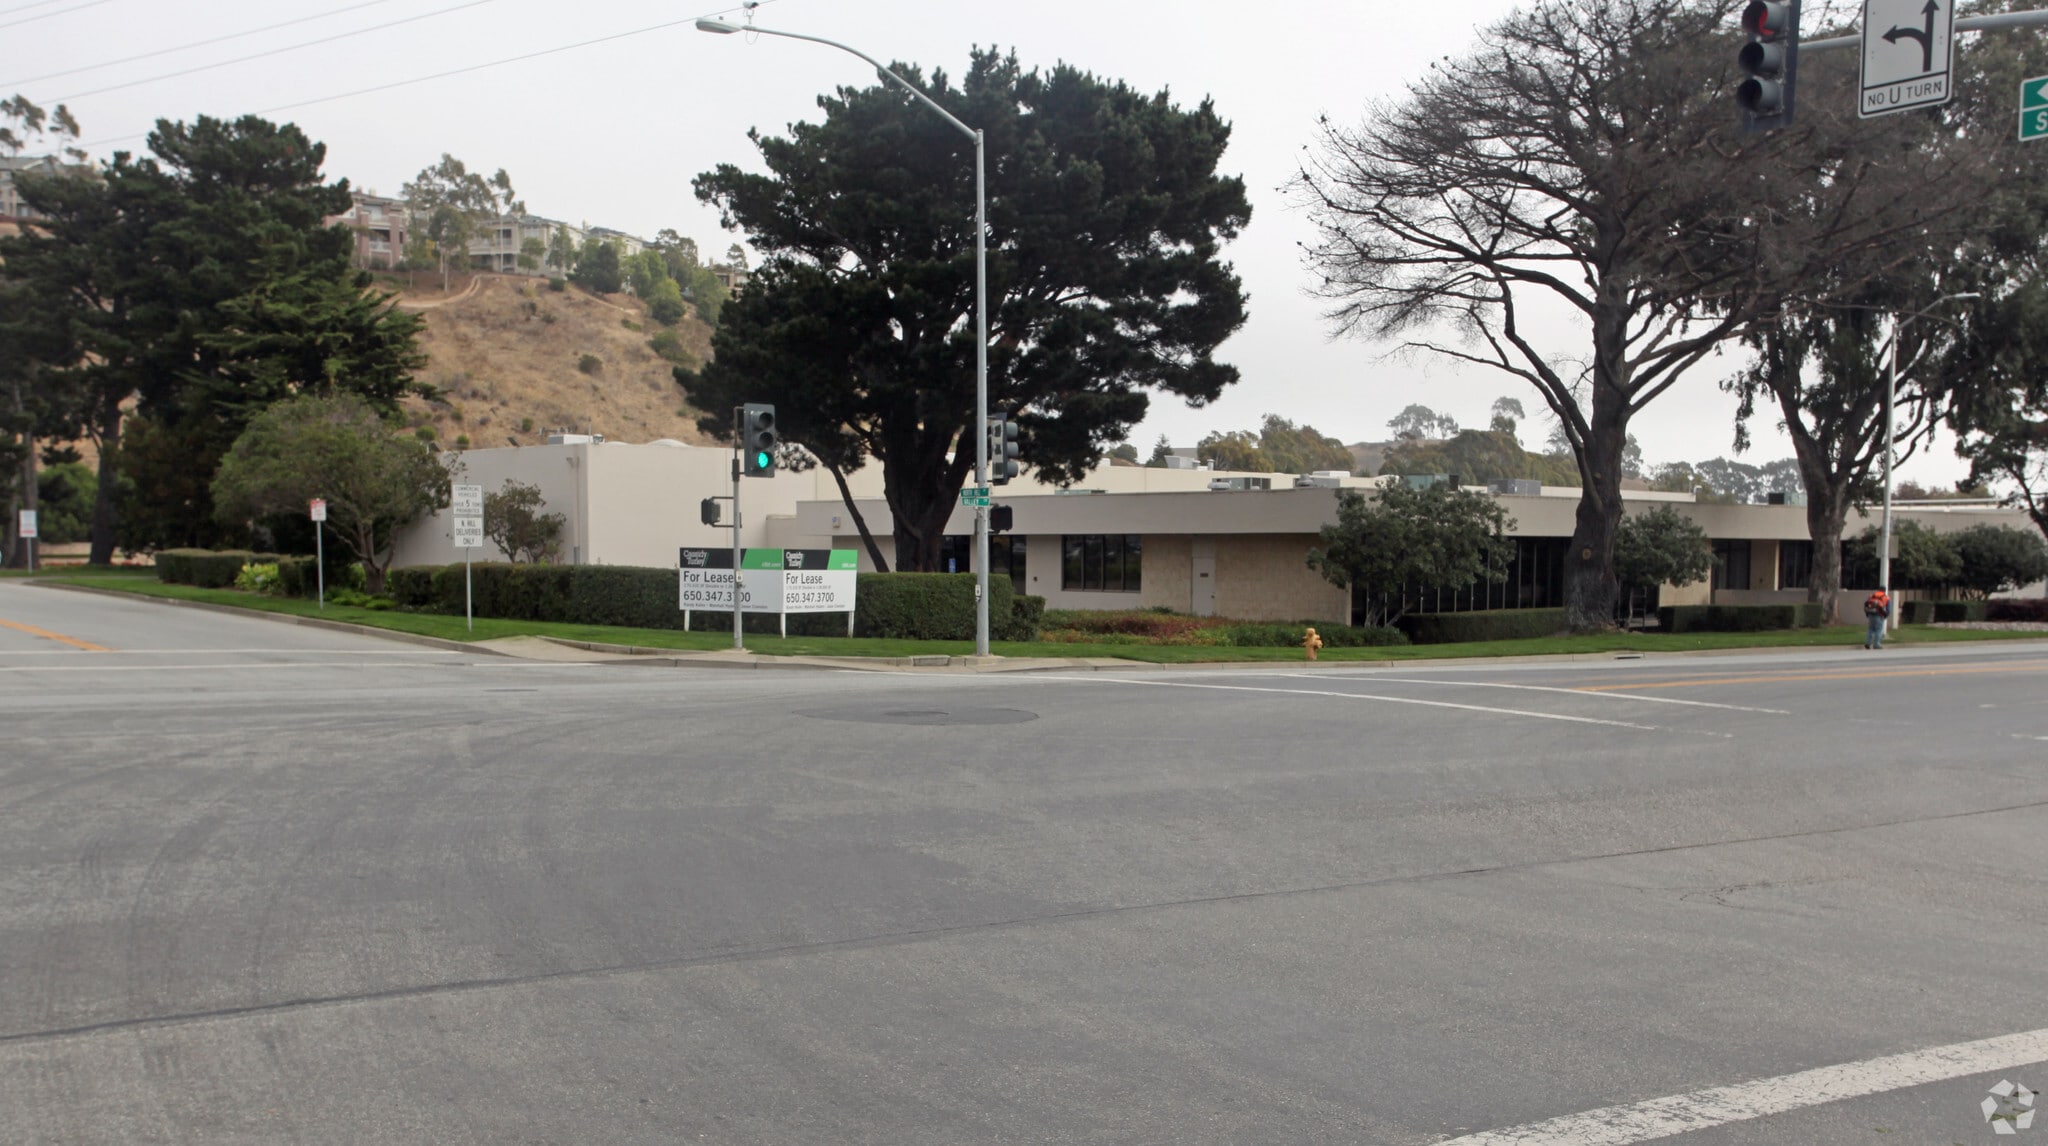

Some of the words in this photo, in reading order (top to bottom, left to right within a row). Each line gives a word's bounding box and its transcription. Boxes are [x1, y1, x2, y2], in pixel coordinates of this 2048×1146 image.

[1867, 92, 1885, 107] NO
[1889, 87, 1901, 105] U
[1906, 80, 1943, 99] TURN
[456, 528, 481, 536] DELIVERIES
[463, 537, 475, 545] ONLY
[683, 570, 700, 582] For
[704, 571, 734, 583] Lease
[785, 572, 799, 584] For
[801, 573, 823, 584] Lease
[785, 592, 835, 604] 650.347.3700
